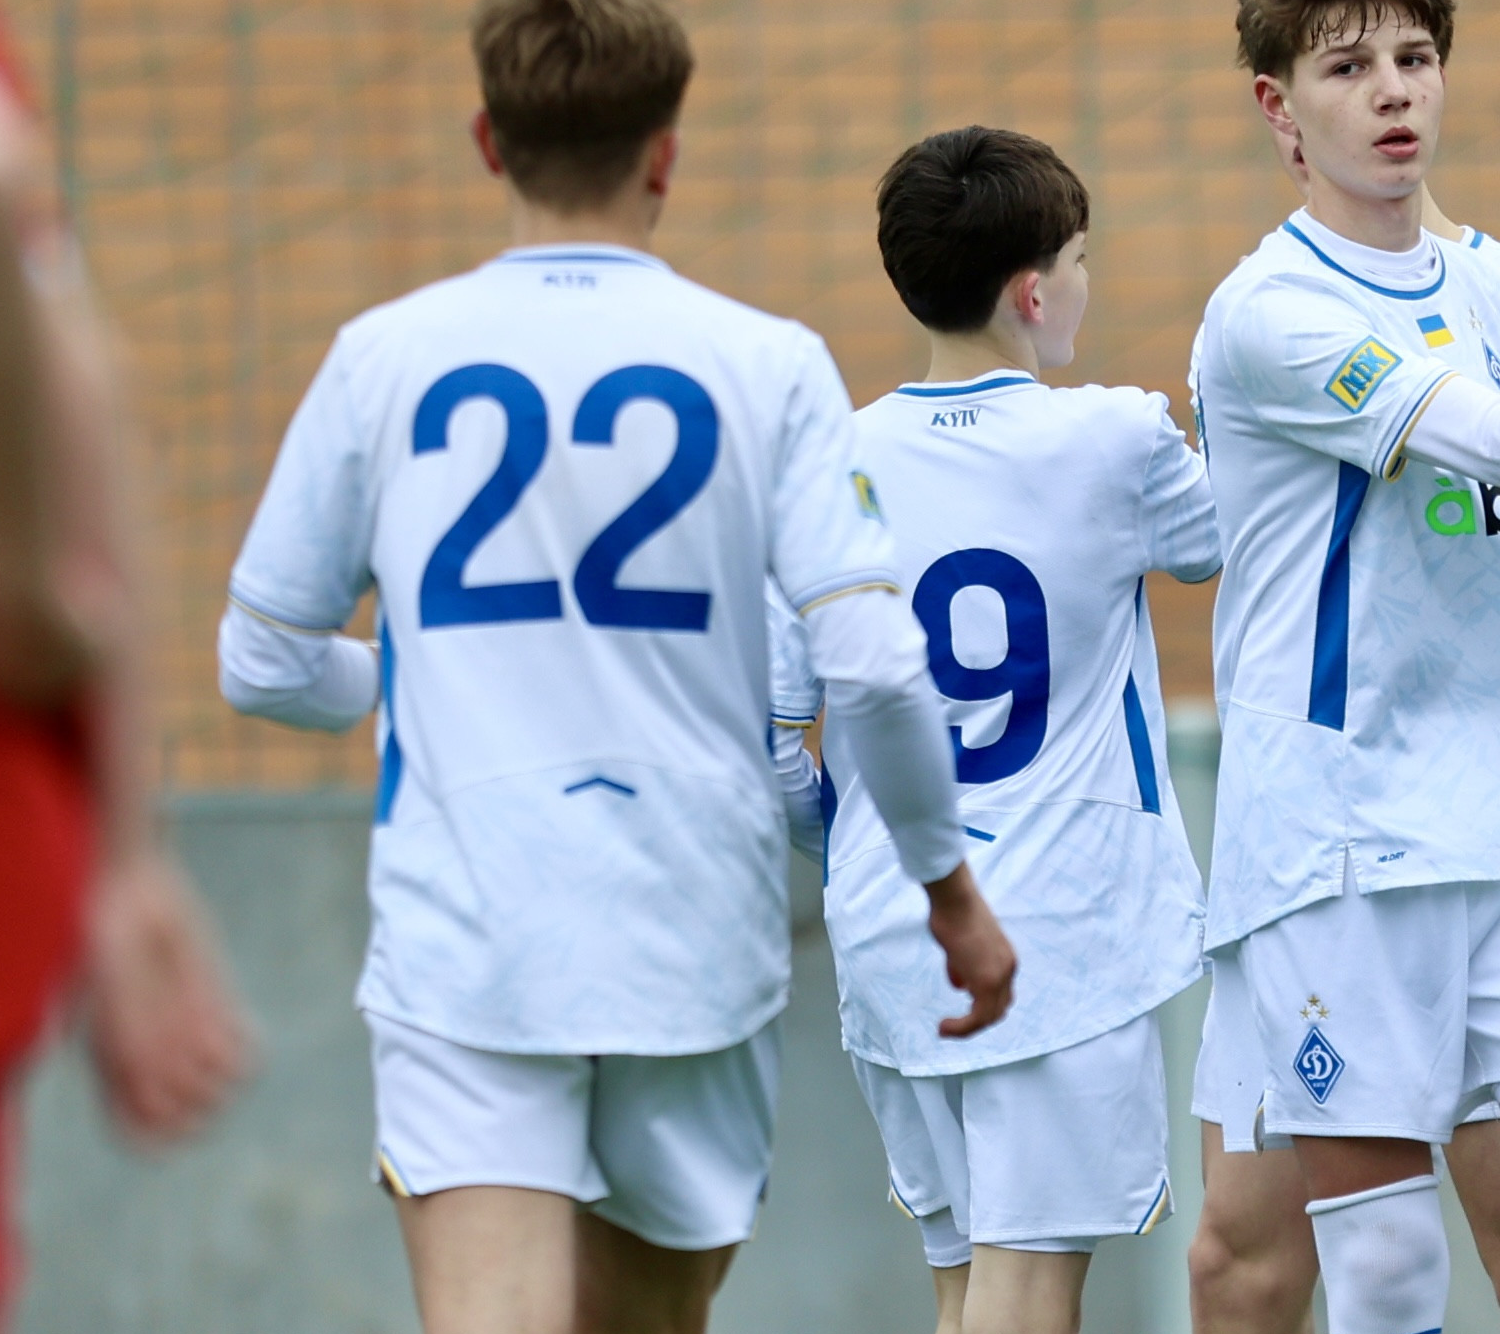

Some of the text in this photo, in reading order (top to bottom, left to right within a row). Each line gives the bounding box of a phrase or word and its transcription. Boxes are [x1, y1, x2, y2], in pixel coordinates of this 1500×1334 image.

[412, 363, 720, 633] 22
[931, 408, 981, 428] KYIV
[911, 547, 1051, 785] 9
